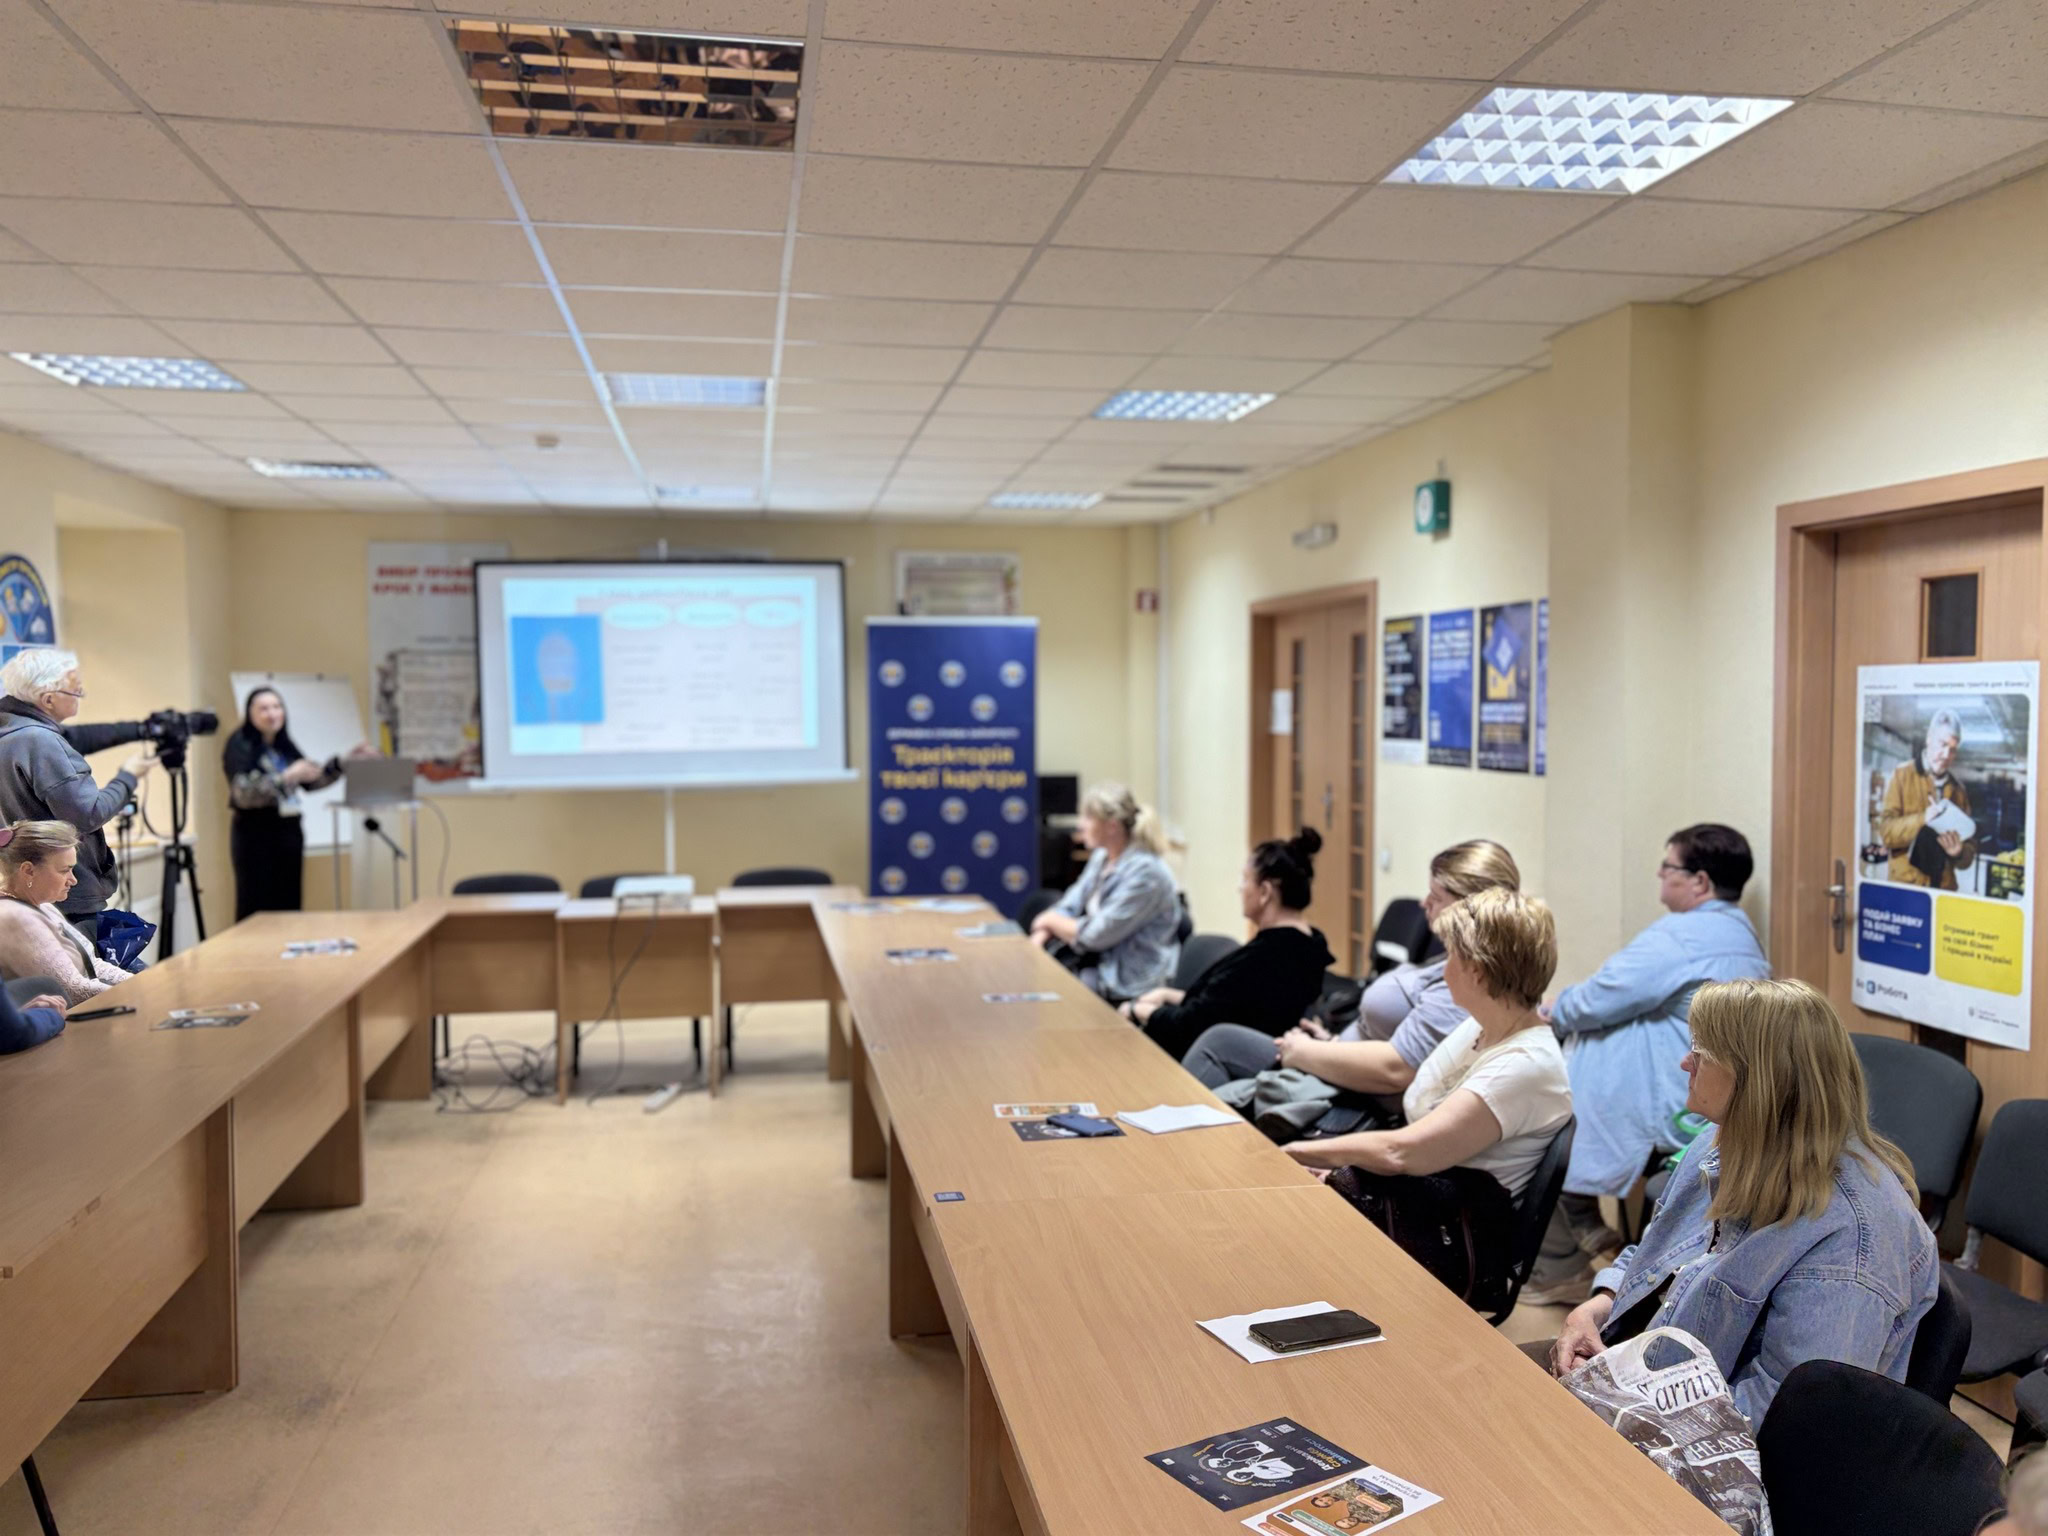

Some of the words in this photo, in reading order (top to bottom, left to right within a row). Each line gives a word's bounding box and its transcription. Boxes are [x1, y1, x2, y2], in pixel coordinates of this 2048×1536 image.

[1863, 908, 1891, 921] ПОДАЙ
[1892, 913, 1923, 928] ЗАЯВКУ
[1863, 919, 1873, 930] ТА
[1874, 921, 1901, 936] БІЗНЕС
[1943, 923, 1976, 937] Отримай
[1977, 931, 2000, 941] грант
[1862, 929, 1885, 944] ПЛАН
[1969, 939, 1994, 951] бізнес
[1285, 1444, 1335, 1471] Державна
